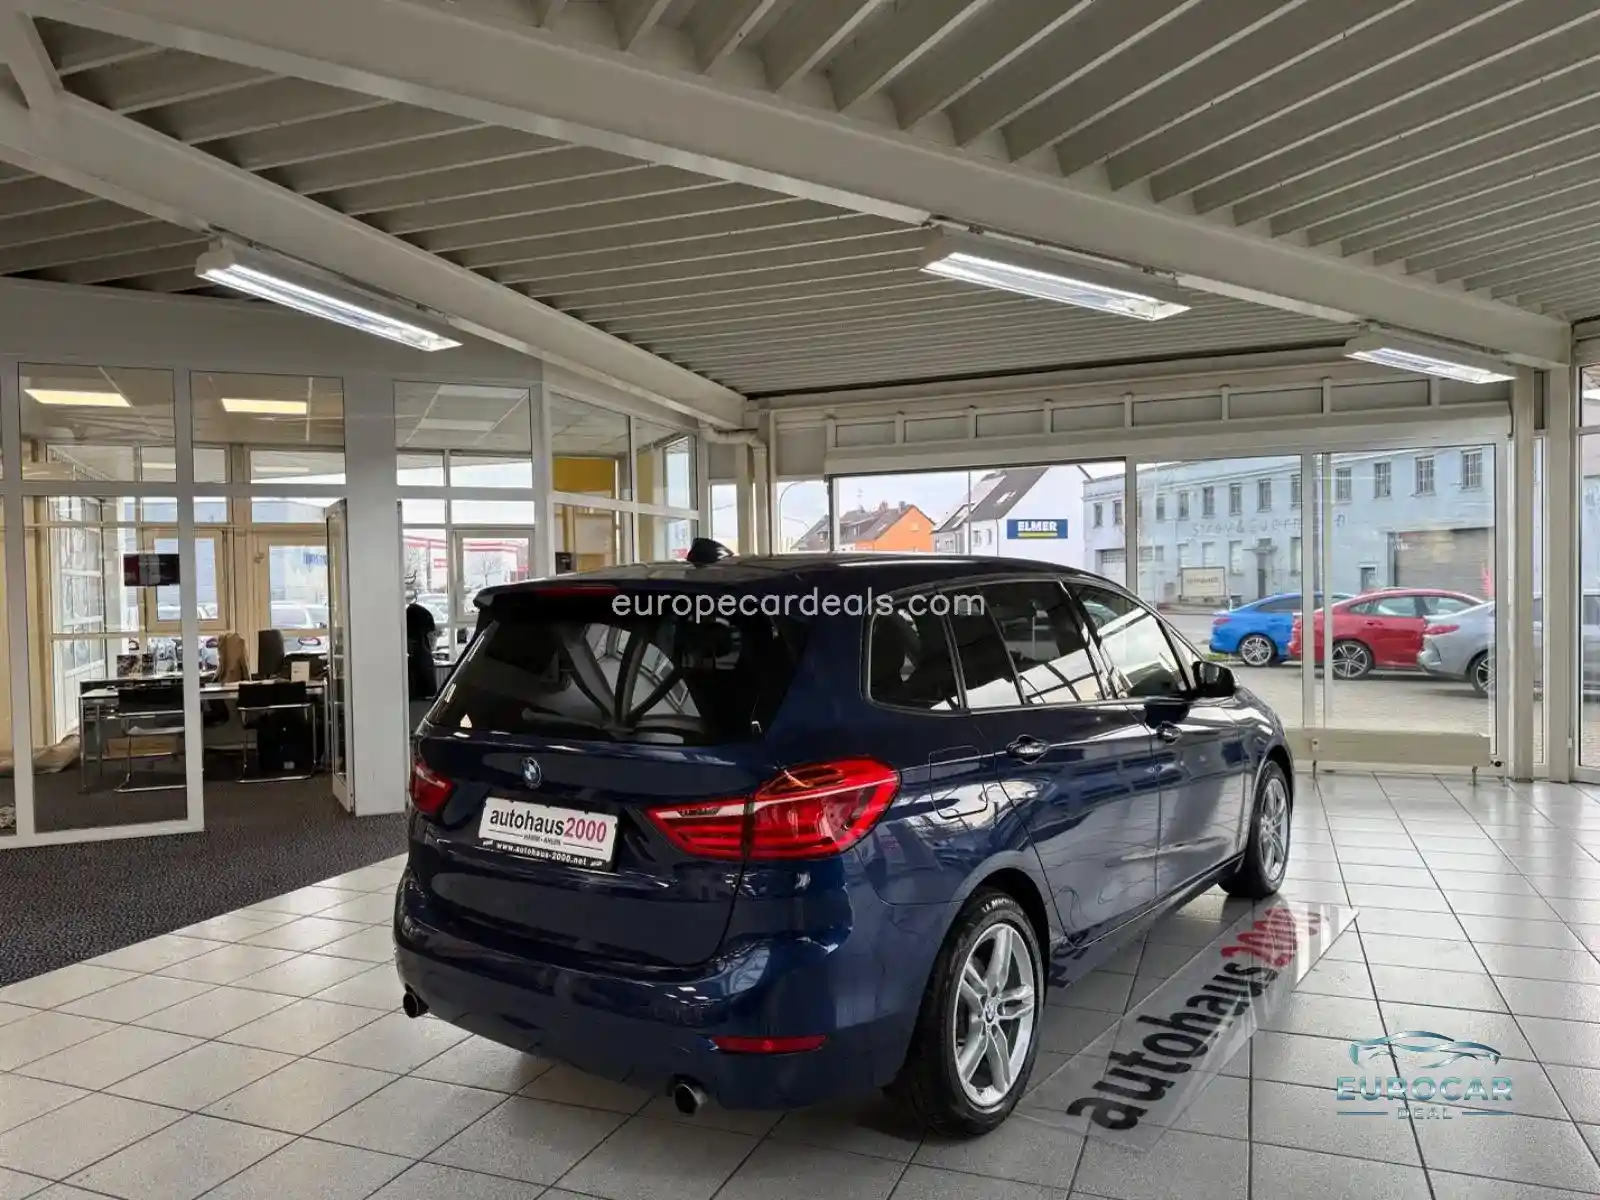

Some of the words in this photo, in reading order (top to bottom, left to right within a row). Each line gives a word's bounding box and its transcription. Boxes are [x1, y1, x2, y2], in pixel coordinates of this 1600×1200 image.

[1017, 520, 1058, 532] ELMER
[489, 808, 607, 843] autohaus2000
[496, 841, 588, 866] www.autohaus-2000.net
